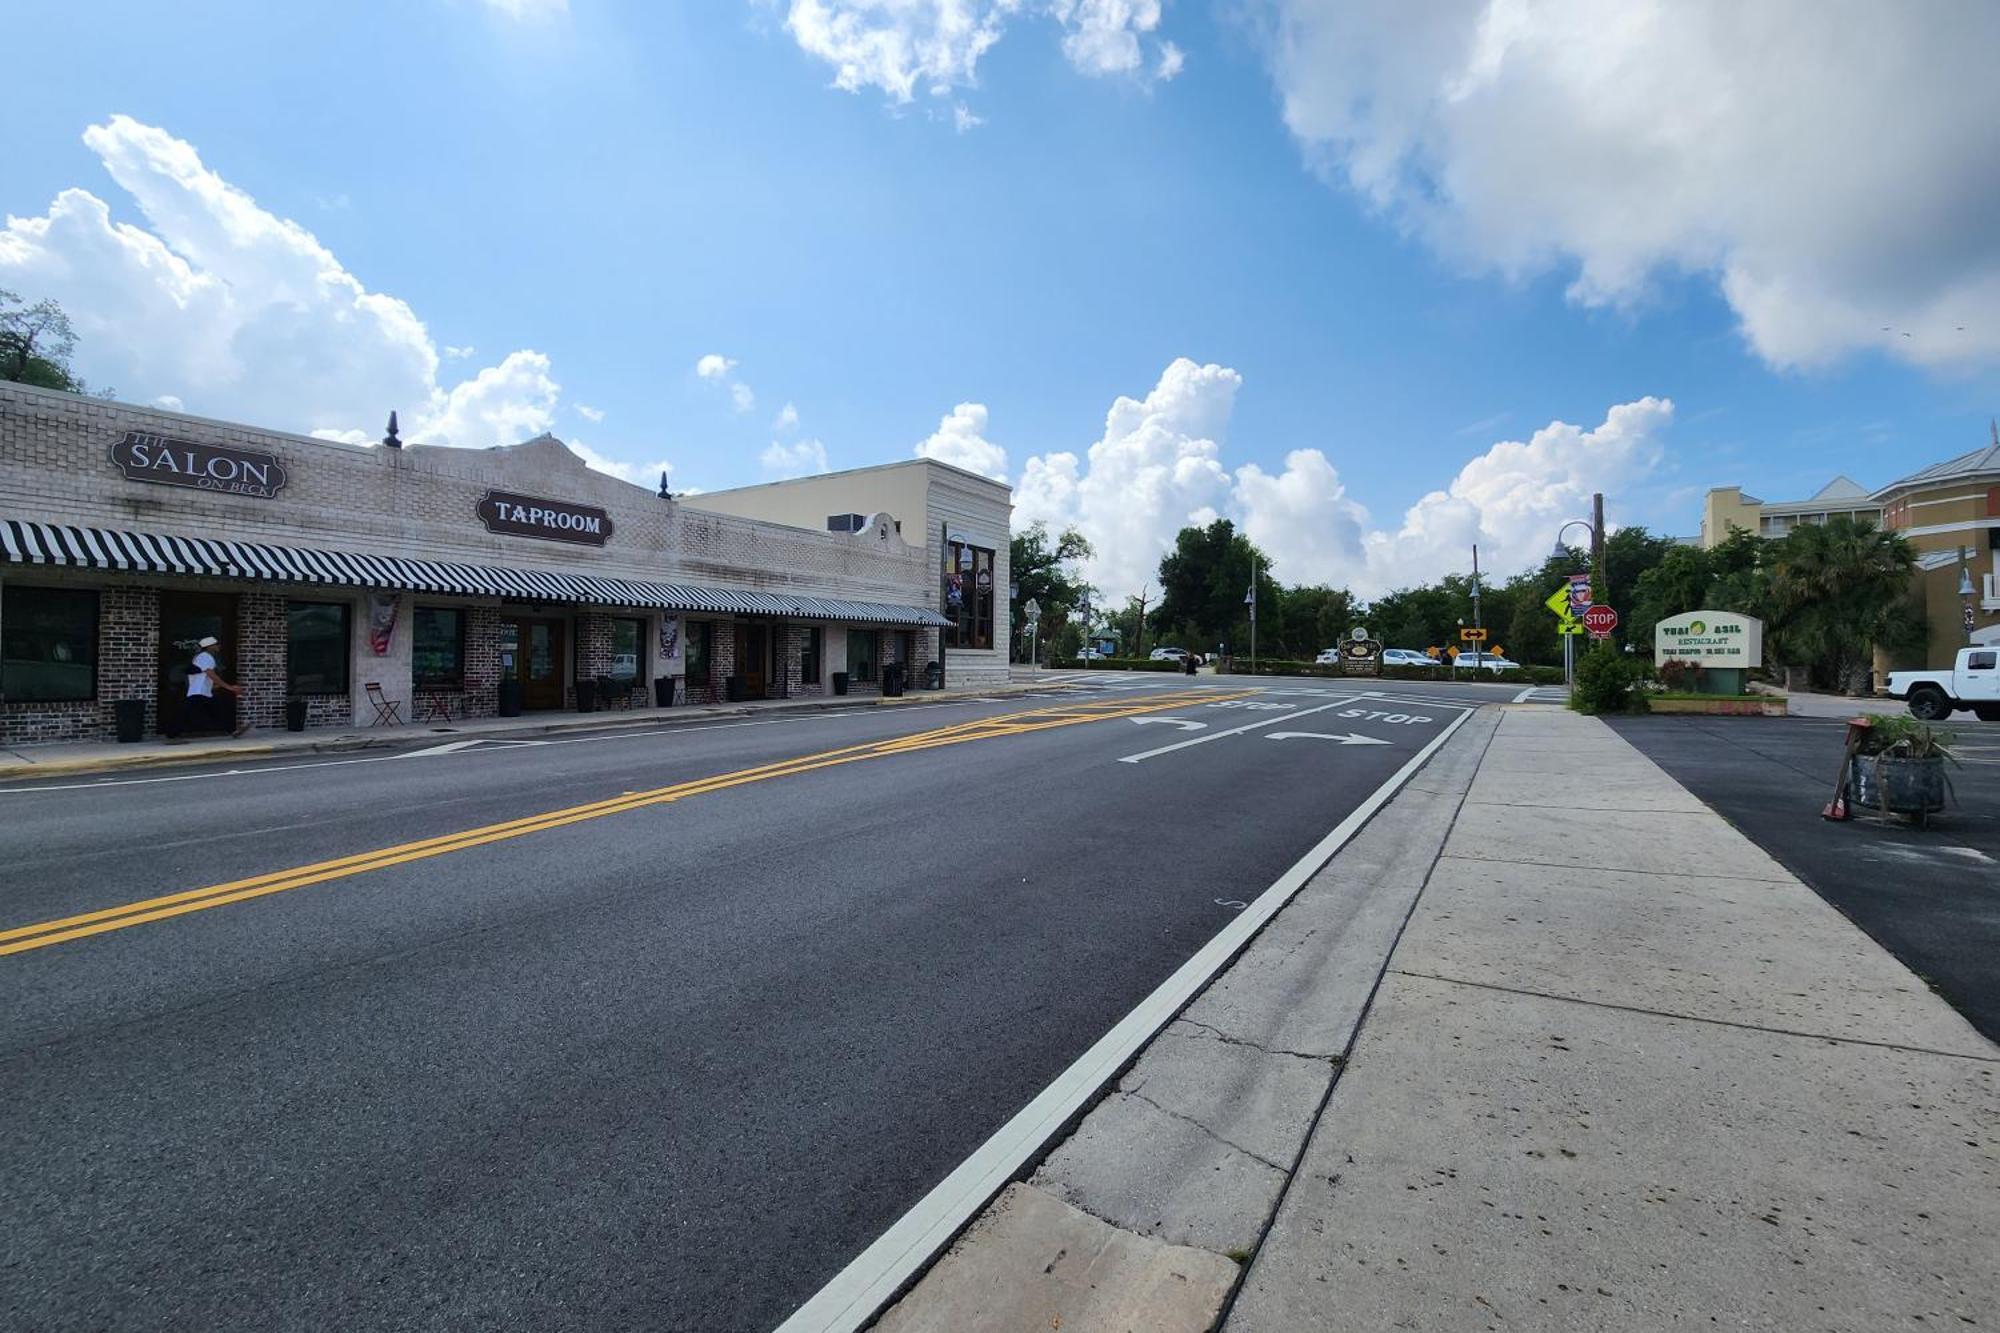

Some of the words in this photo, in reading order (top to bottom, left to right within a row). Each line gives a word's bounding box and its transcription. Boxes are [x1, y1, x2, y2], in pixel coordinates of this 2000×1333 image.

[133, 434, 168, 448] THE
[130, 444, 270, 485] SALON
[197, 478, 226, 490] ON
[229, 482, 270, 496] BECK
[495, 502, 600, 534] TAPROOM
[1585, 614, 1615, 625] STOP
[1663, 627, 1689, 636] THAI
[1678, 637, 1729, 646] RESTAURANT
[1337, 708, 1433, 725] STOP
